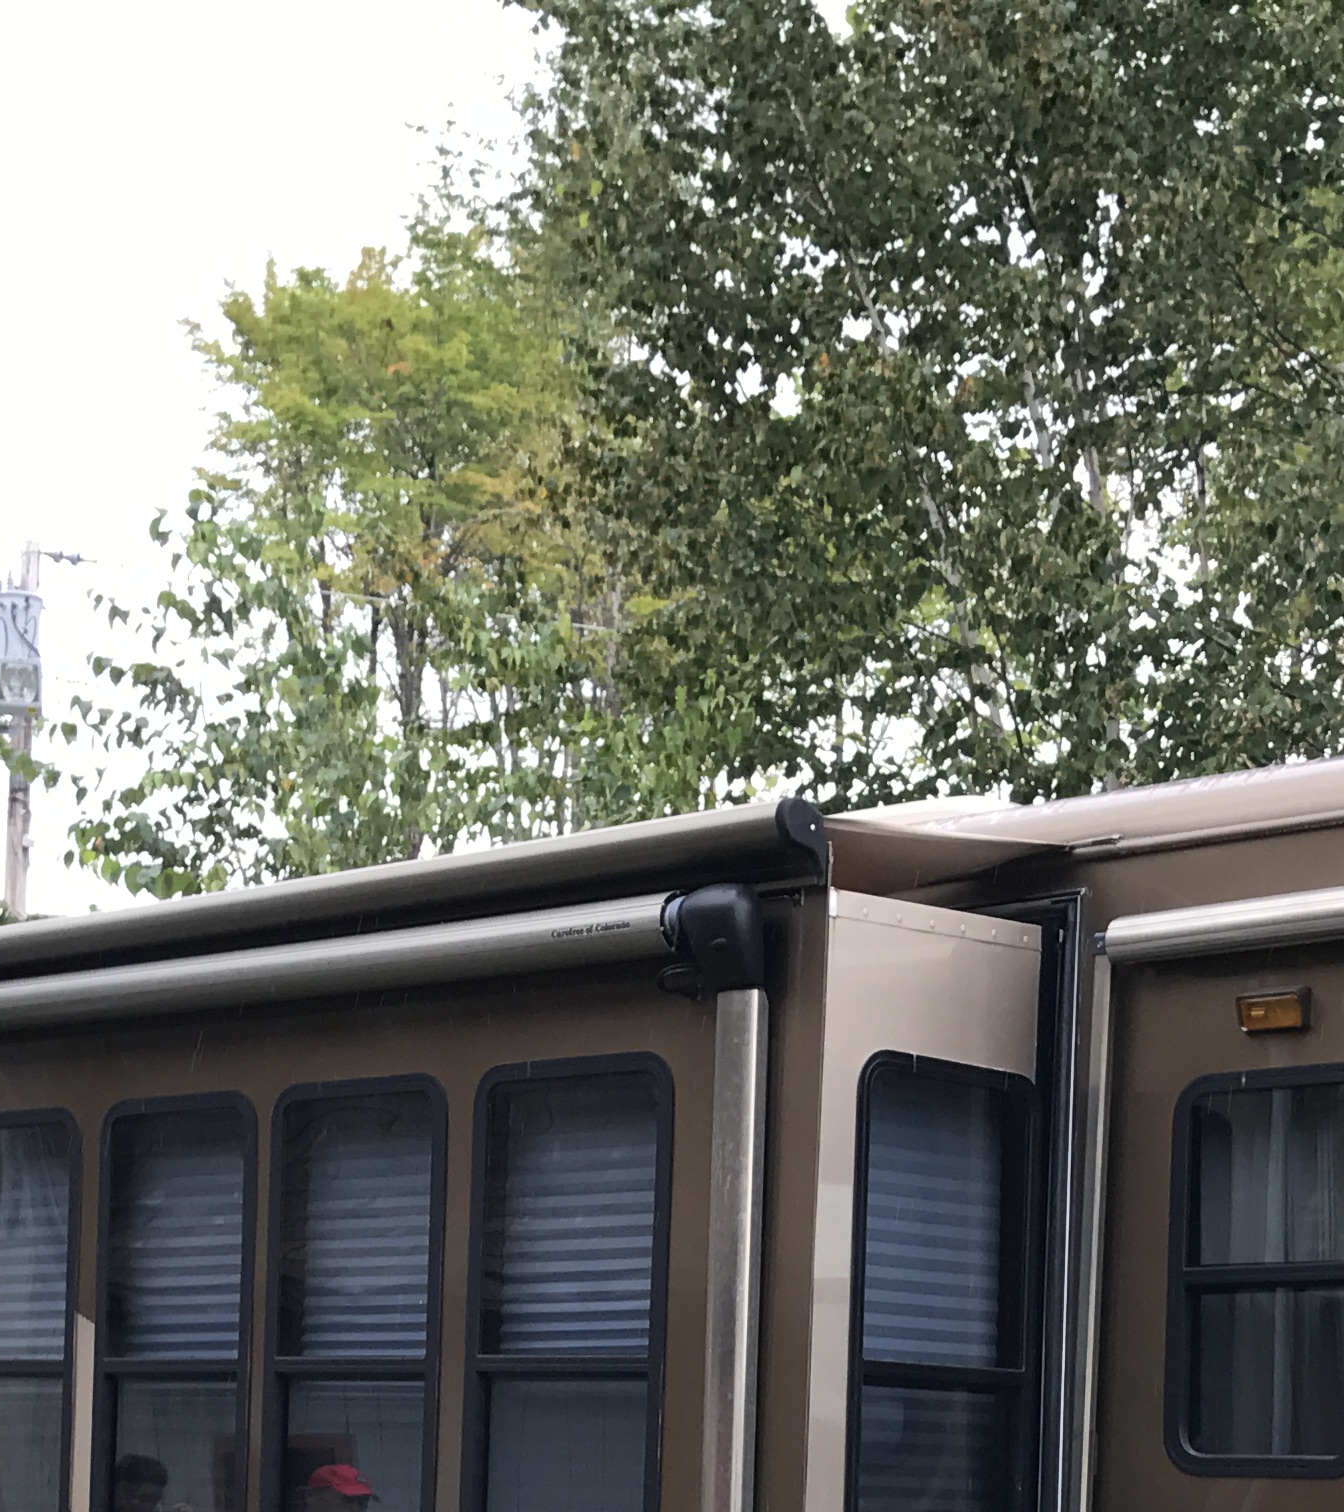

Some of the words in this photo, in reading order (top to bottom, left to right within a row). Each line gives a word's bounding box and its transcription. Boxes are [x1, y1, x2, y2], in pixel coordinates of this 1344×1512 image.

[551, 927, 584, 938] Carefree
[585, 924, 594, 934] of
[595, 921, 630, 931] Colorado
